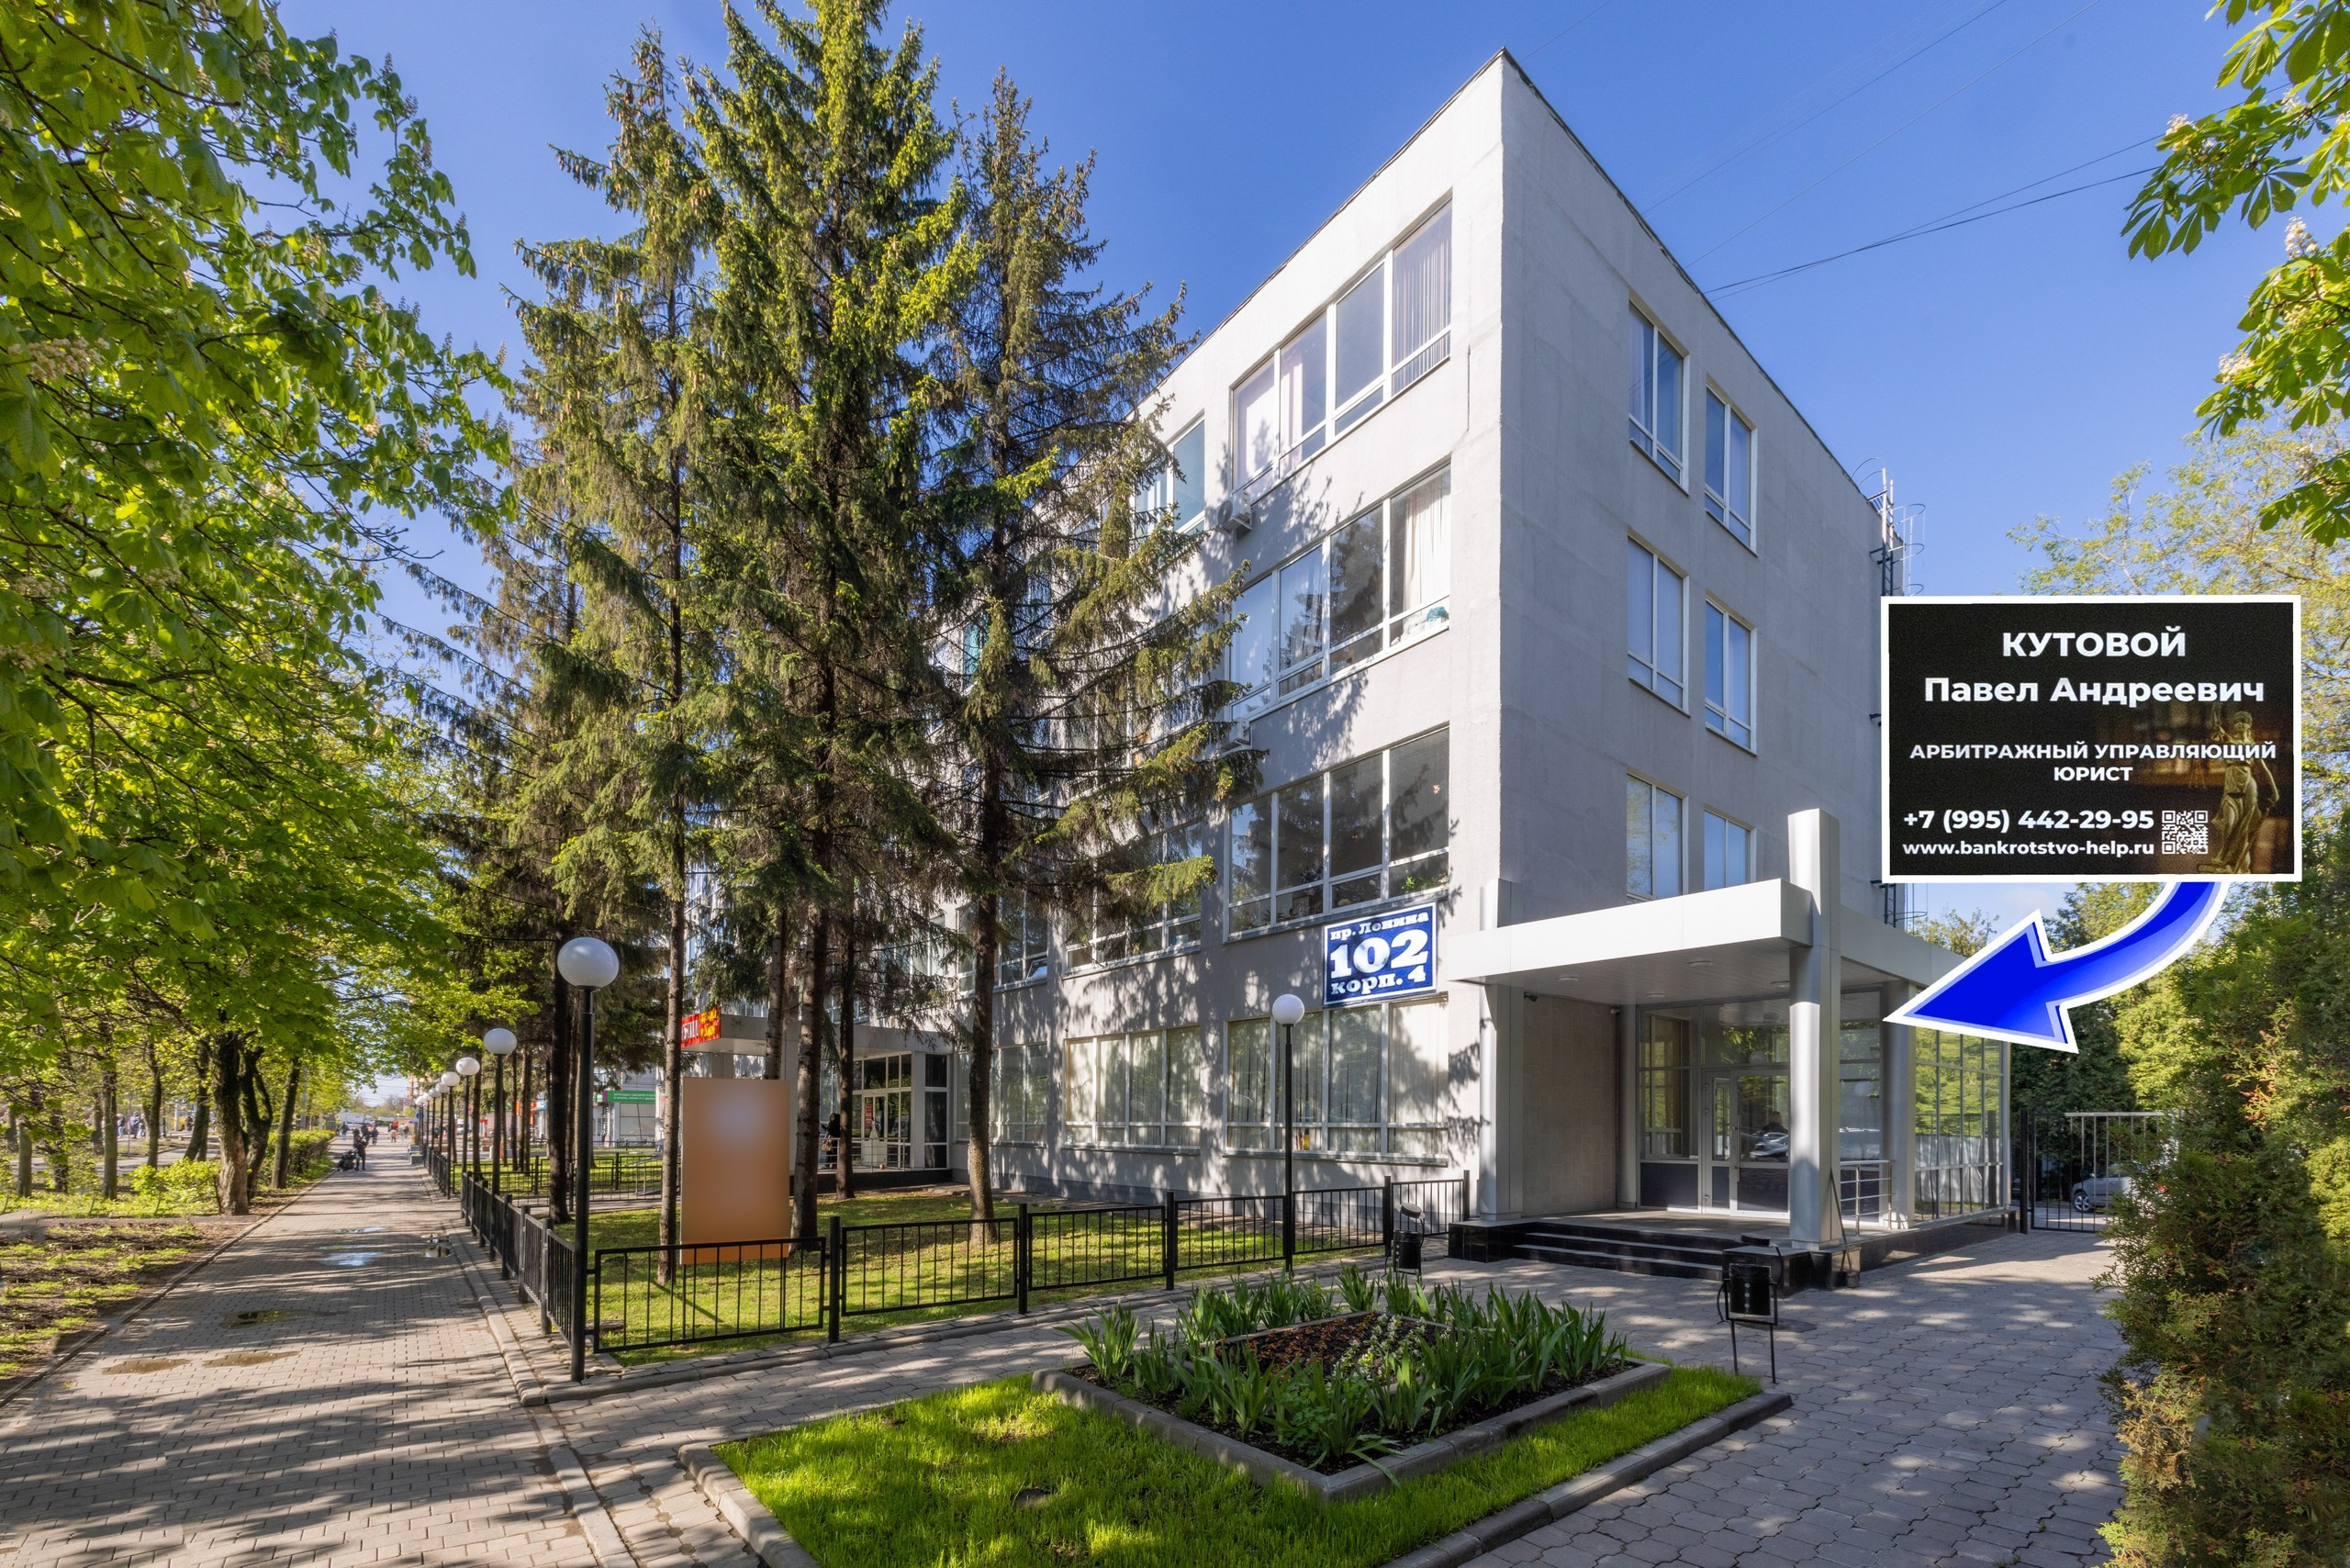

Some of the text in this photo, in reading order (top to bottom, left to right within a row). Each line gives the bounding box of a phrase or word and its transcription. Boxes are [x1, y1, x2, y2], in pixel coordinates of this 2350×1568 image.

[1330, 912, 1429, 941] пр. Ленина
[1331, 928, 1428, 979] 102
[1331, 965, 1427, 994] корп. 4
